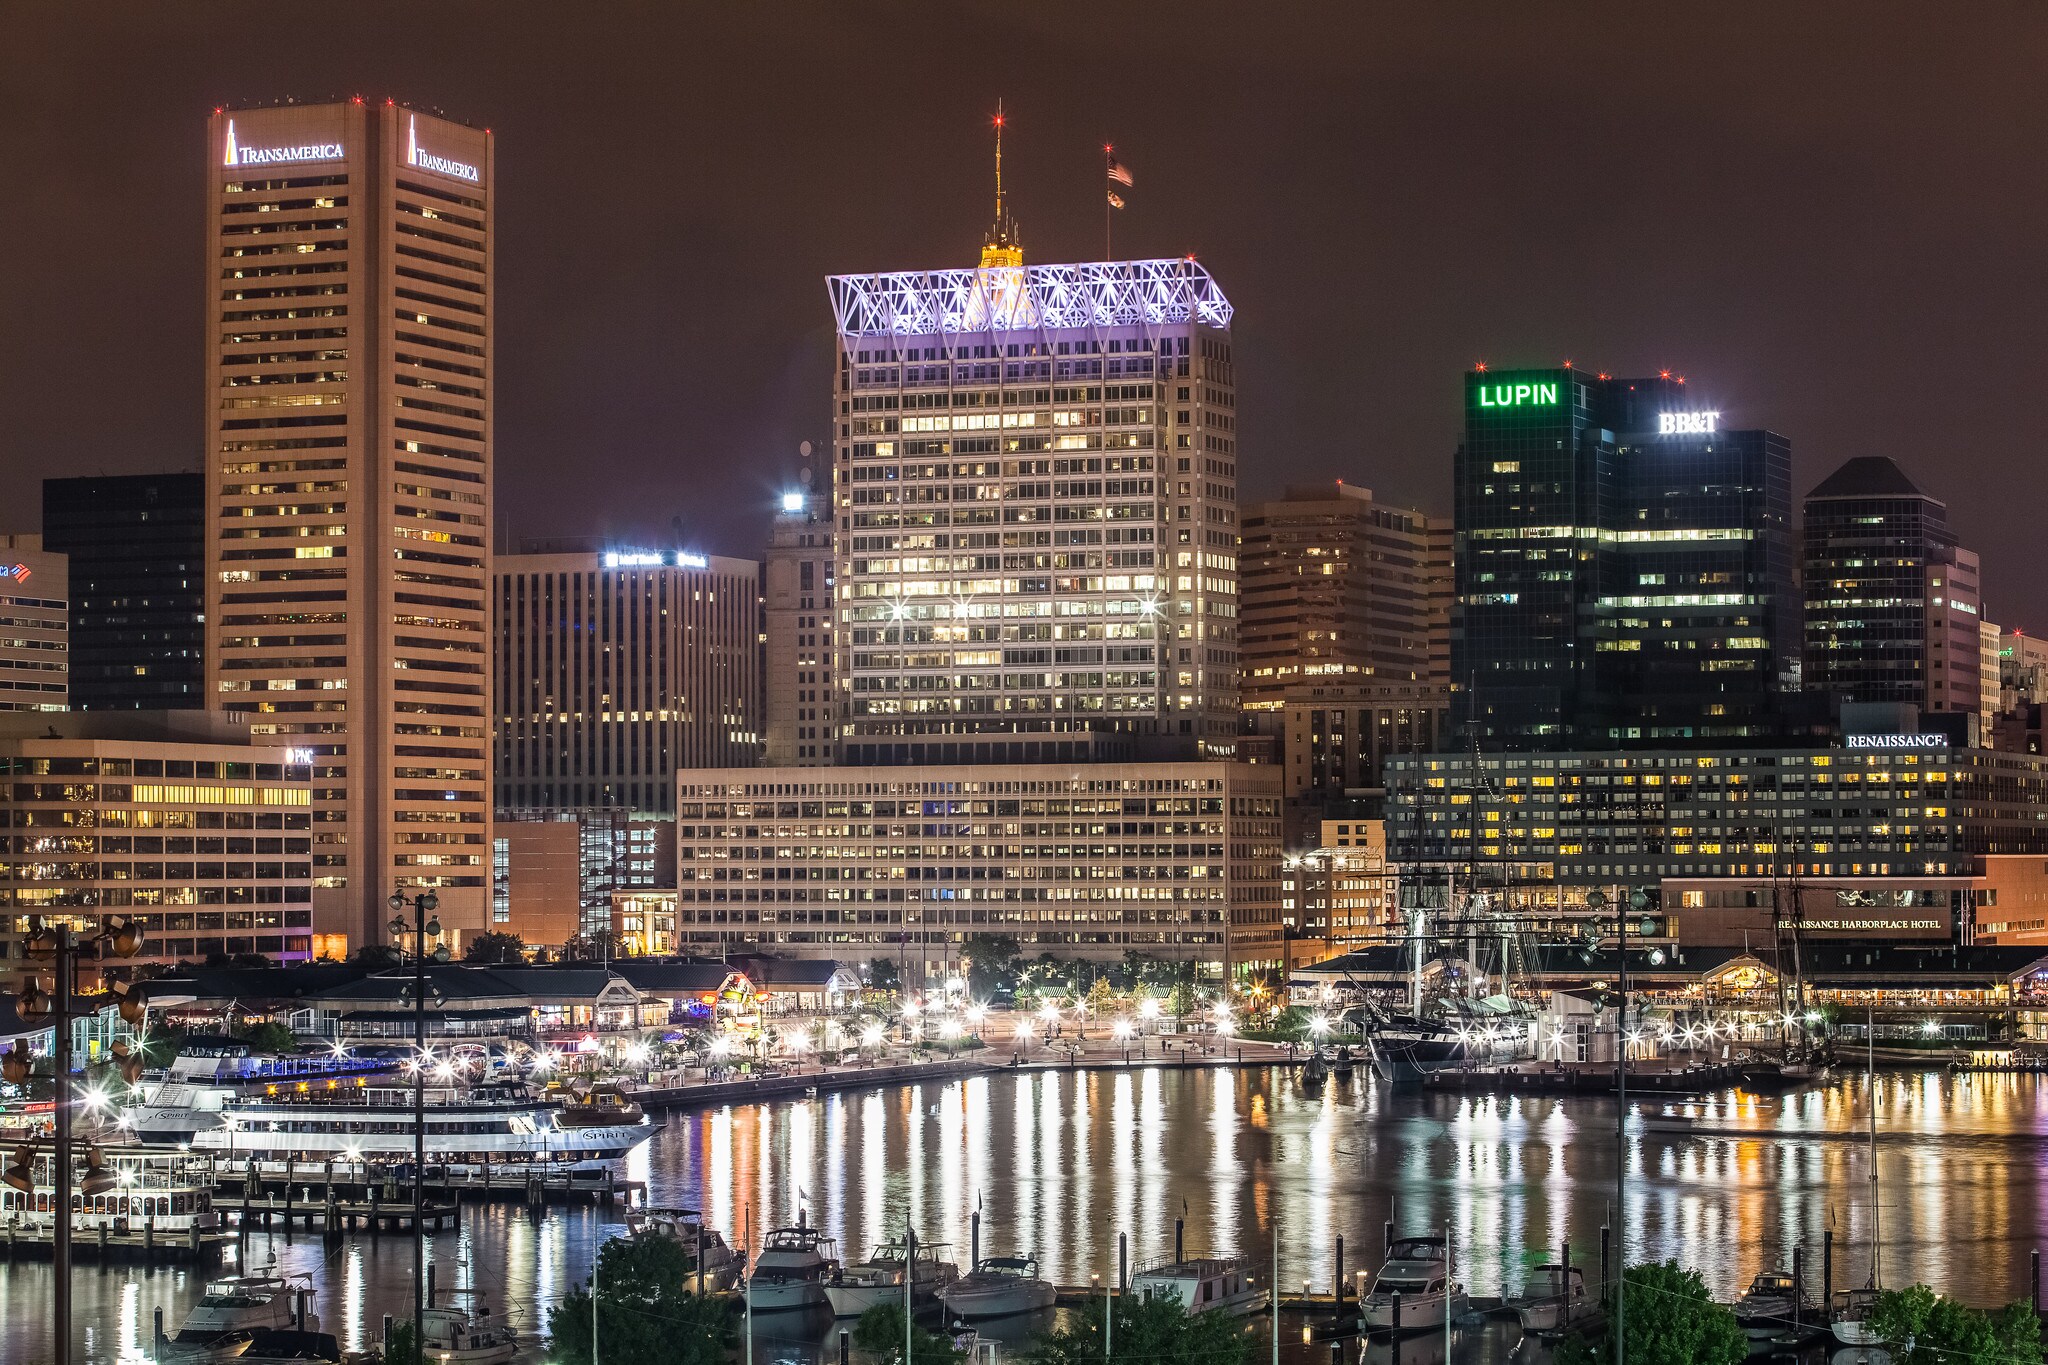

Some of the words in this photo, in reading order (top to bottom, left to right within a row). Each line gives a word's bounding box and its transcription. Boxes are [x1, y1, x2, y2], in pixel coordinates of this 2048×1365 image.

[239, 144, 344, 164] TRANSAMERICA
[1480, 384, 1557, 407] LUPIN
[1658, 412, 1719, 435] BB&T
[294, 749, 314, 764] PNC
[1841, 920, 1908, 929] HARBORPLACE
[1910, 920, 1941, 929] HOTEL
[158, 1111, 190, 1119] SPIRIT
[583, 1131, 629, 1140] SPIRIT
